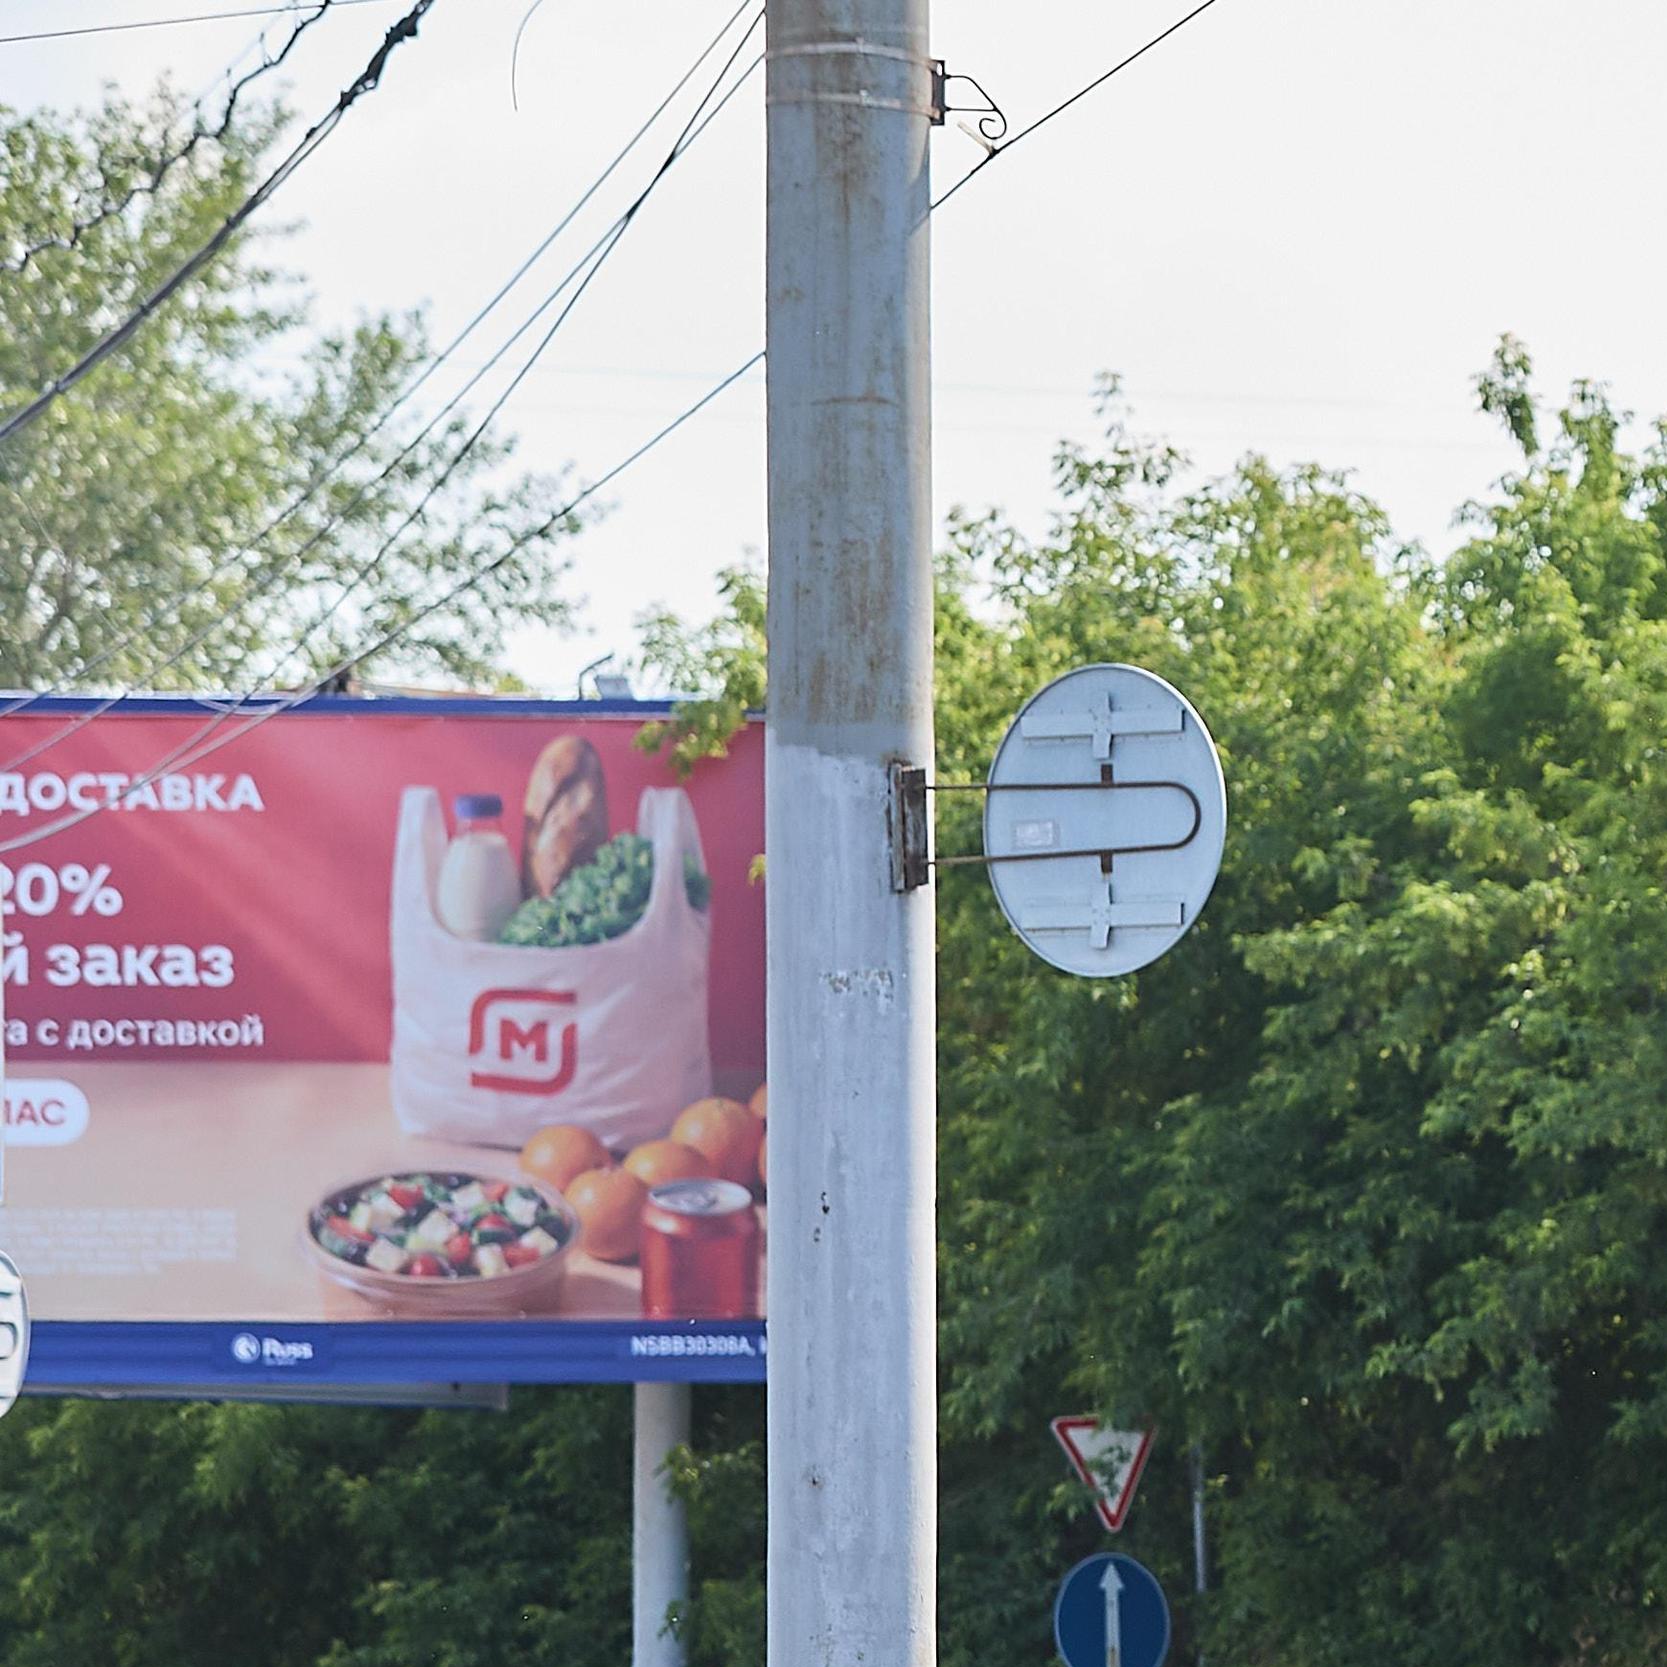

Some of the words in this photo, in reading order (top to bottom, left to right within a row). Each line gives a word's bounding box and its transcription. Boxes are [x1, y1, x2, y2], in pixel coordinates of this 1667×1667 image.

[0, 771, 265, 816] ДОСТАВКА
[46, 943, 235, 987] заказ
[36, 1019, 59, 1046] с
[67, 1013, 265, 1050] доставкой
